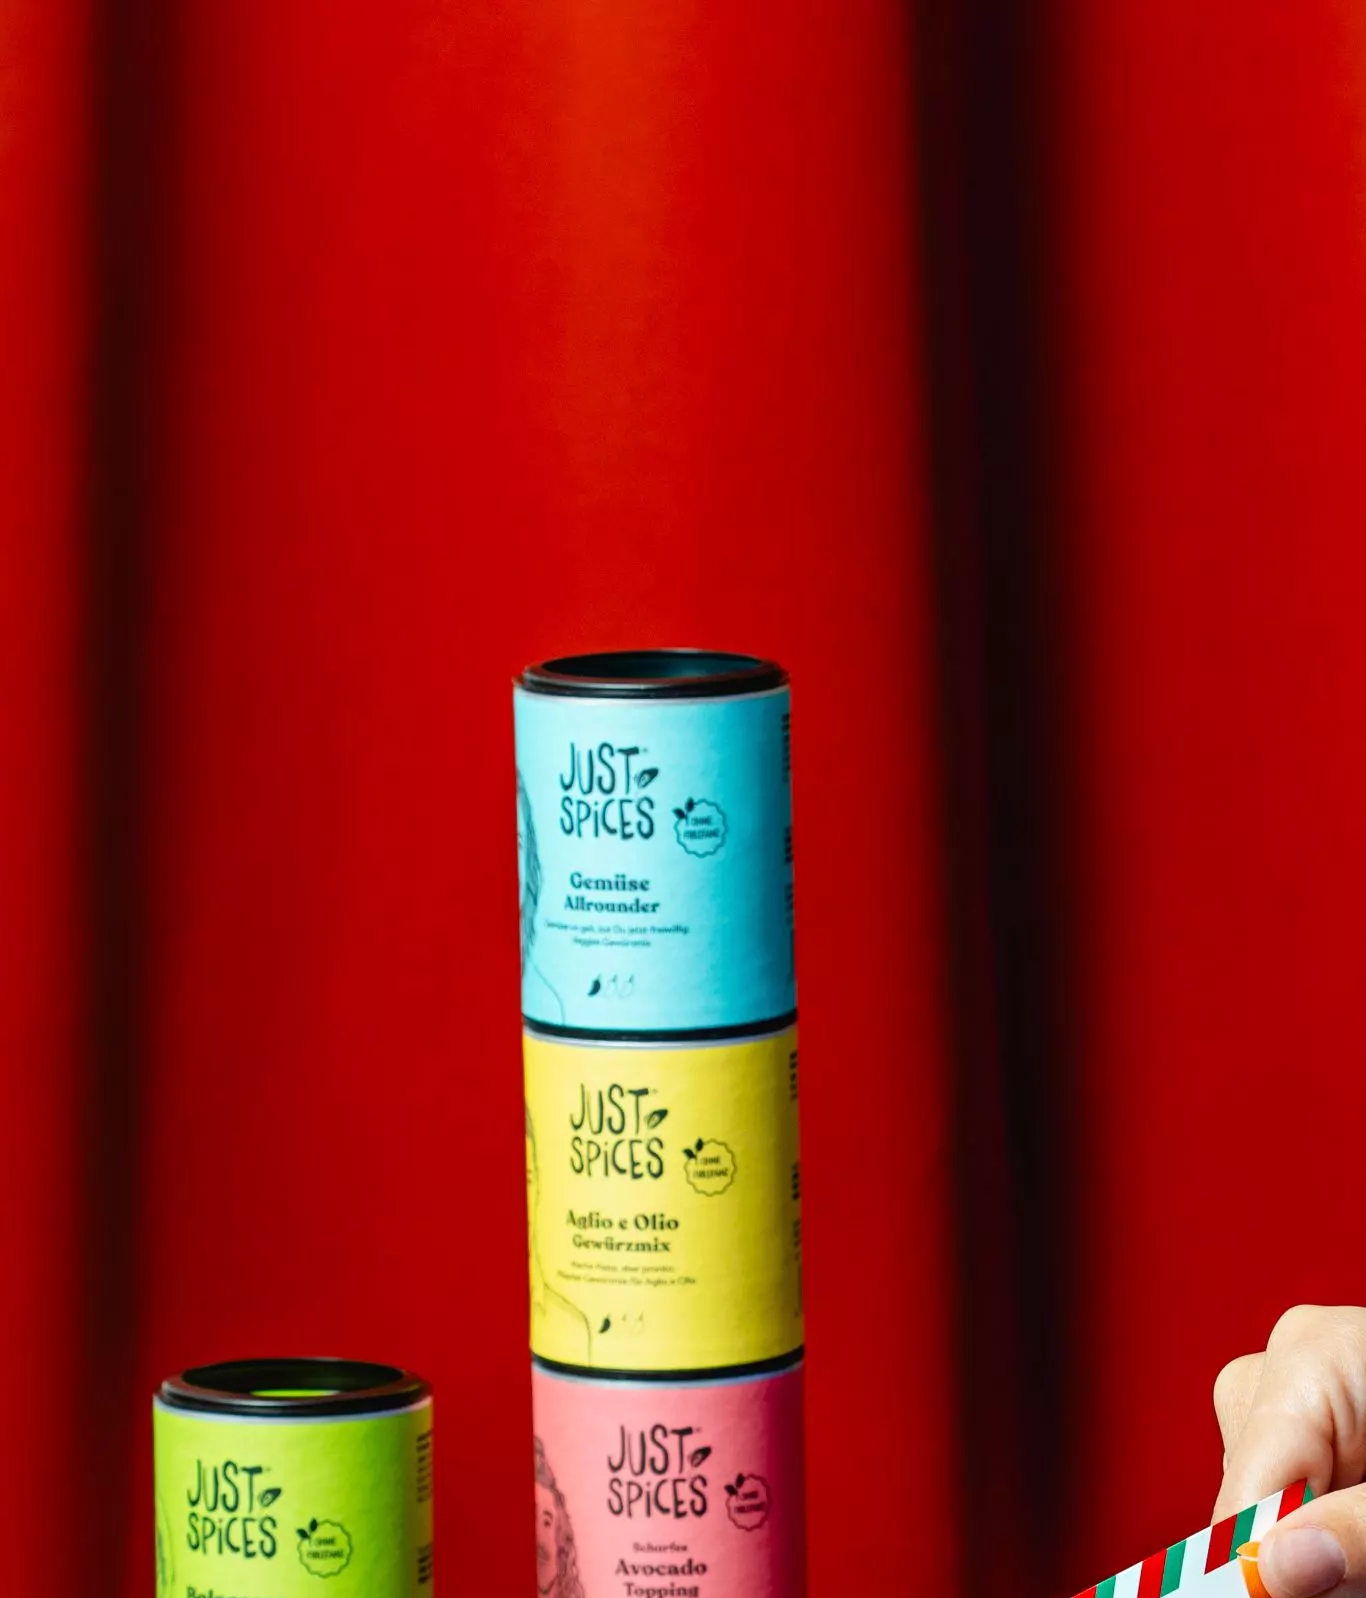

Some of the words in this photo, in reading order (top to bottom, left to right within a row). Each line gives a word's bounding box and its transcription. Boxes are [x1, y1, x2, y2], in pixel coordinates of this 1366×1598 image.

[570, 872, 650, 892] Gemüse
[564, 896, 660, 914] Allrounder
[566, 1209, 613, 1229] Aglio
[618, 1219, 628, 1230] e
[634, 1212, 679, 1231] Olio
[572, 1234, 671, 1252] Gewürzmix
[615, 1558, 707, 1577] Avocado
